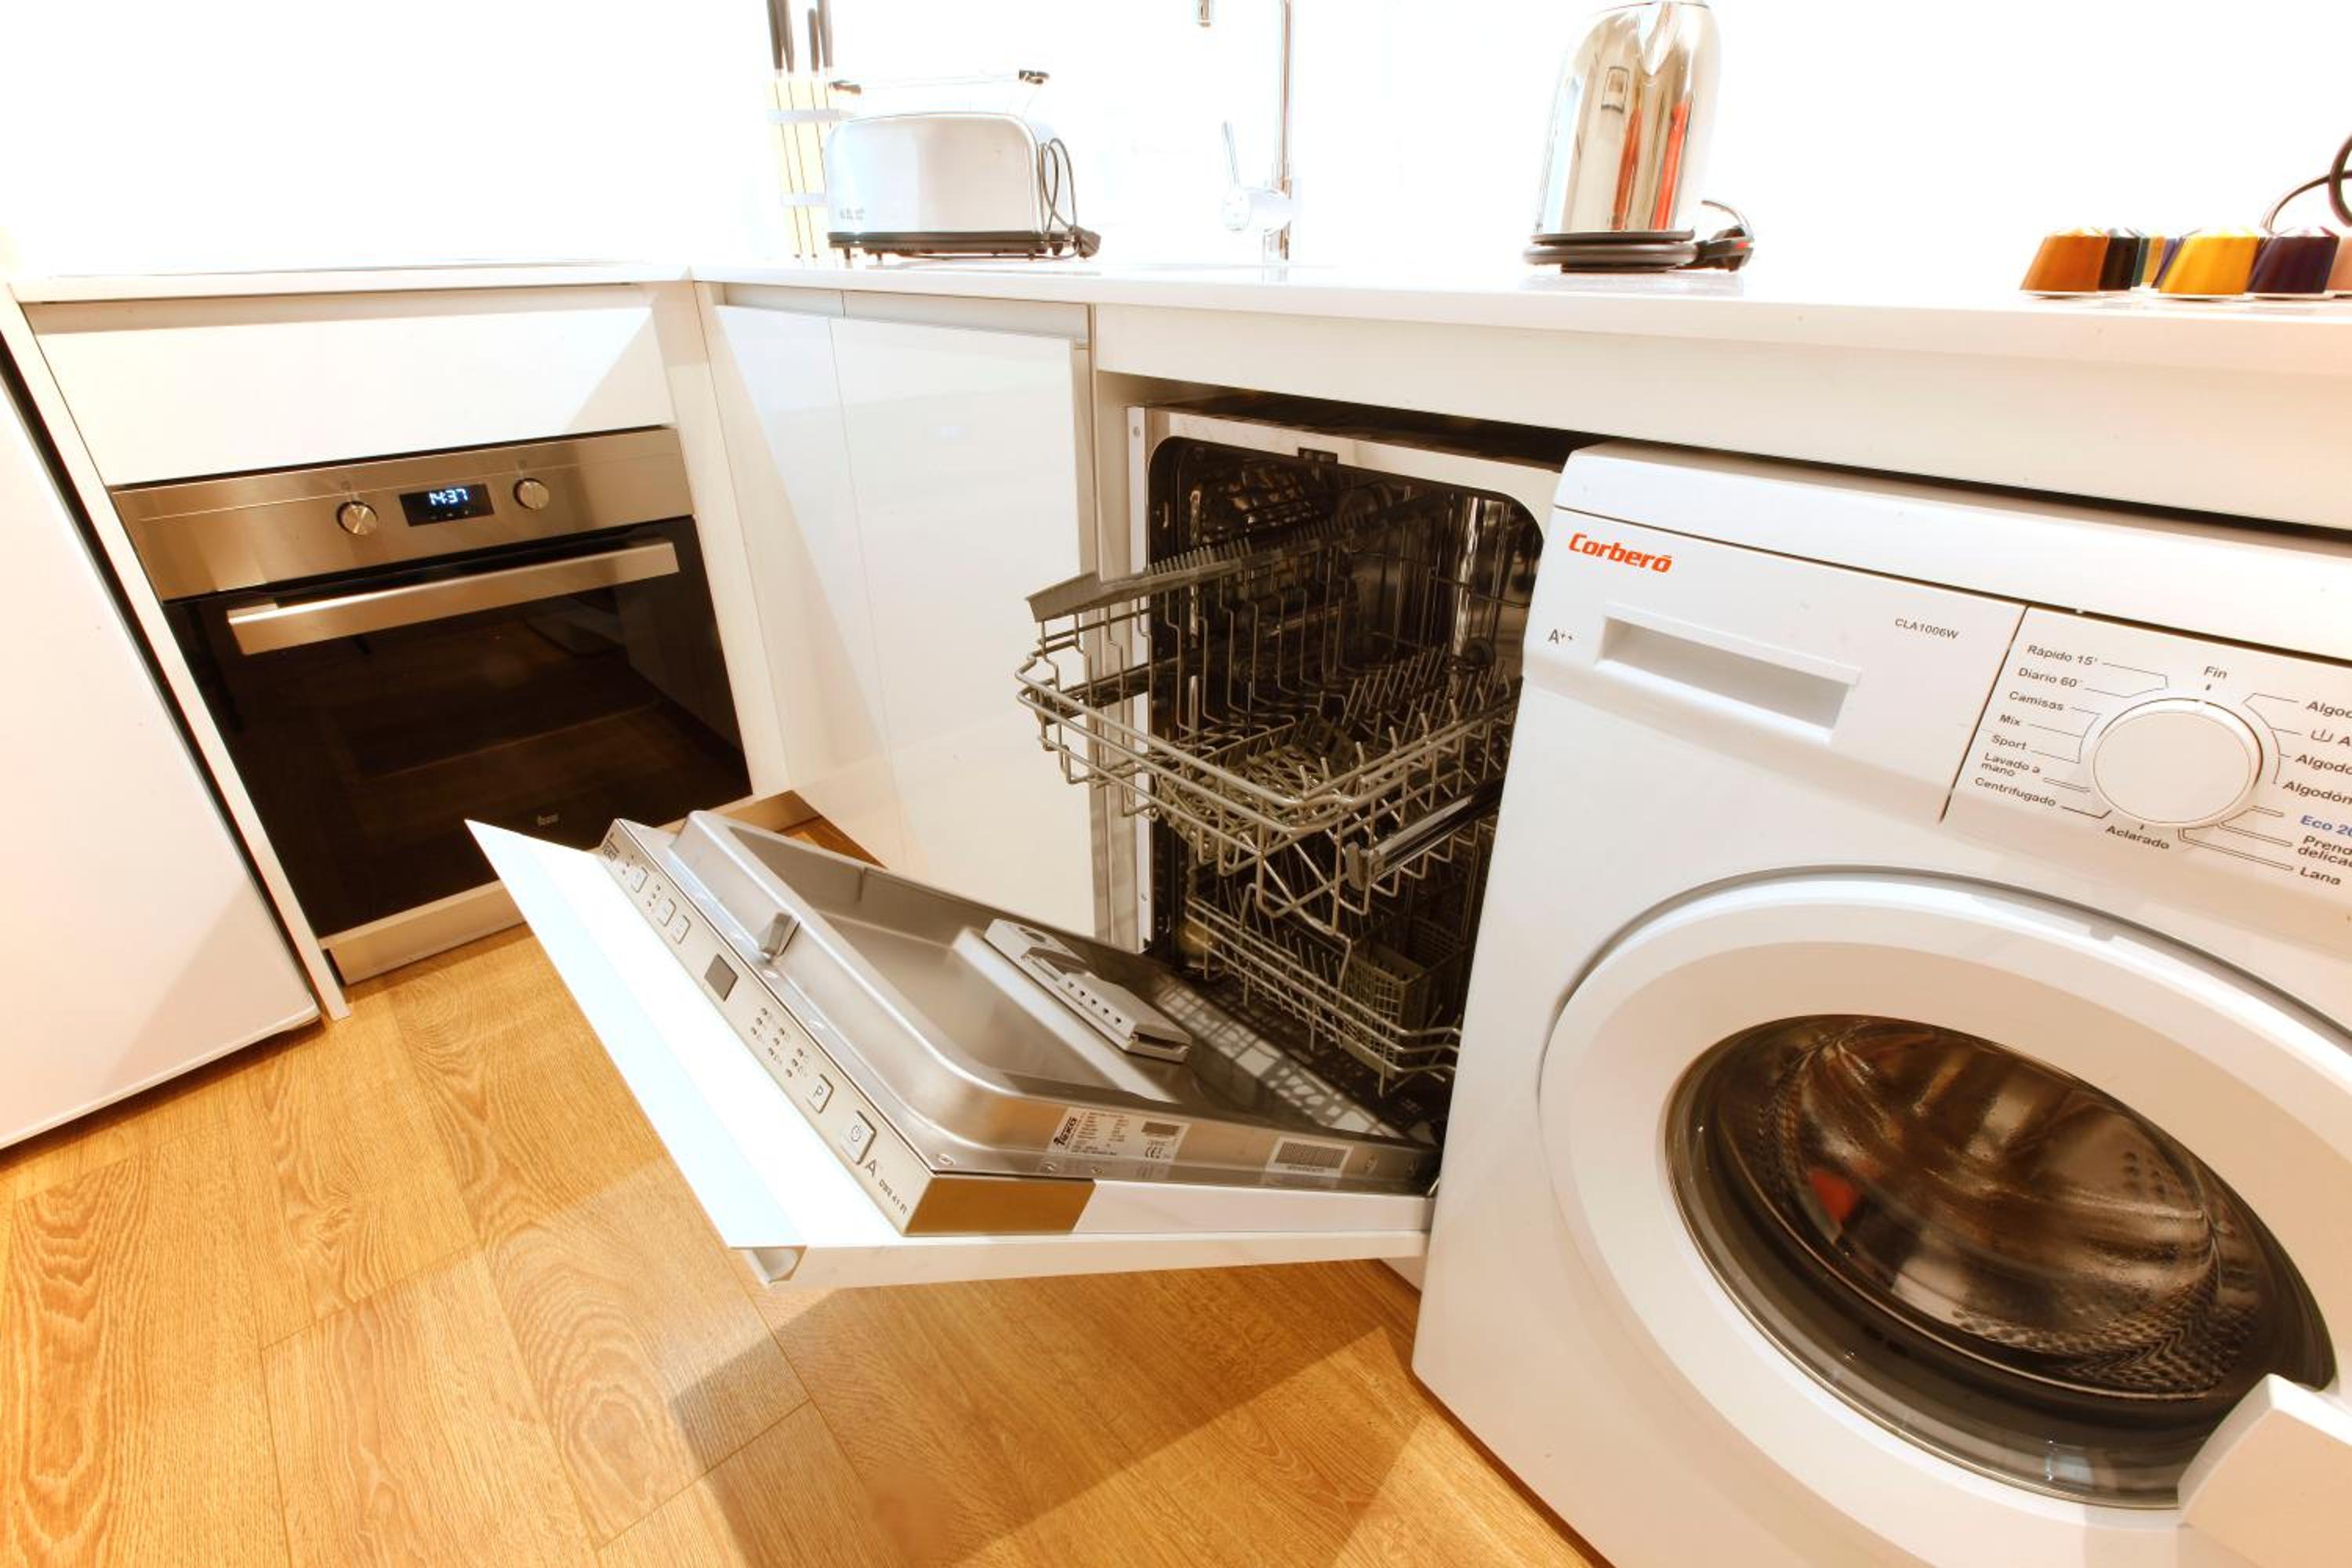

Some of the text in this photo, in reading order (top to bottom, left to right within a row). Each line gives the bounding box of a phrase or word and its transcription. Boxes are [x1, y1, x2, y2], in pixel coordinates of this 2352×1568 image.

[429, 488, 468, 506] 14:37
[2019, 667, 2057, 684] Diario
[2204, 666, 2227, 679] Fin
[2009, 691, 2064, 711] Camisas
[2000, 714, 2020, 726] Mix
[1991, 735, 2027, 750] Sport
[1981, 763, 2015, 777] mano
[1984, 752, 2041, 774] Lavado a
[1975, 777, 2056, 808] Centrifugado
[2300, 815, 2332, 830] Eco
[2106, 825, 2169, 849] Aclarado
[2298, 847, 2352, 868] delica
[2300, 867, 2341, 885] Lana
